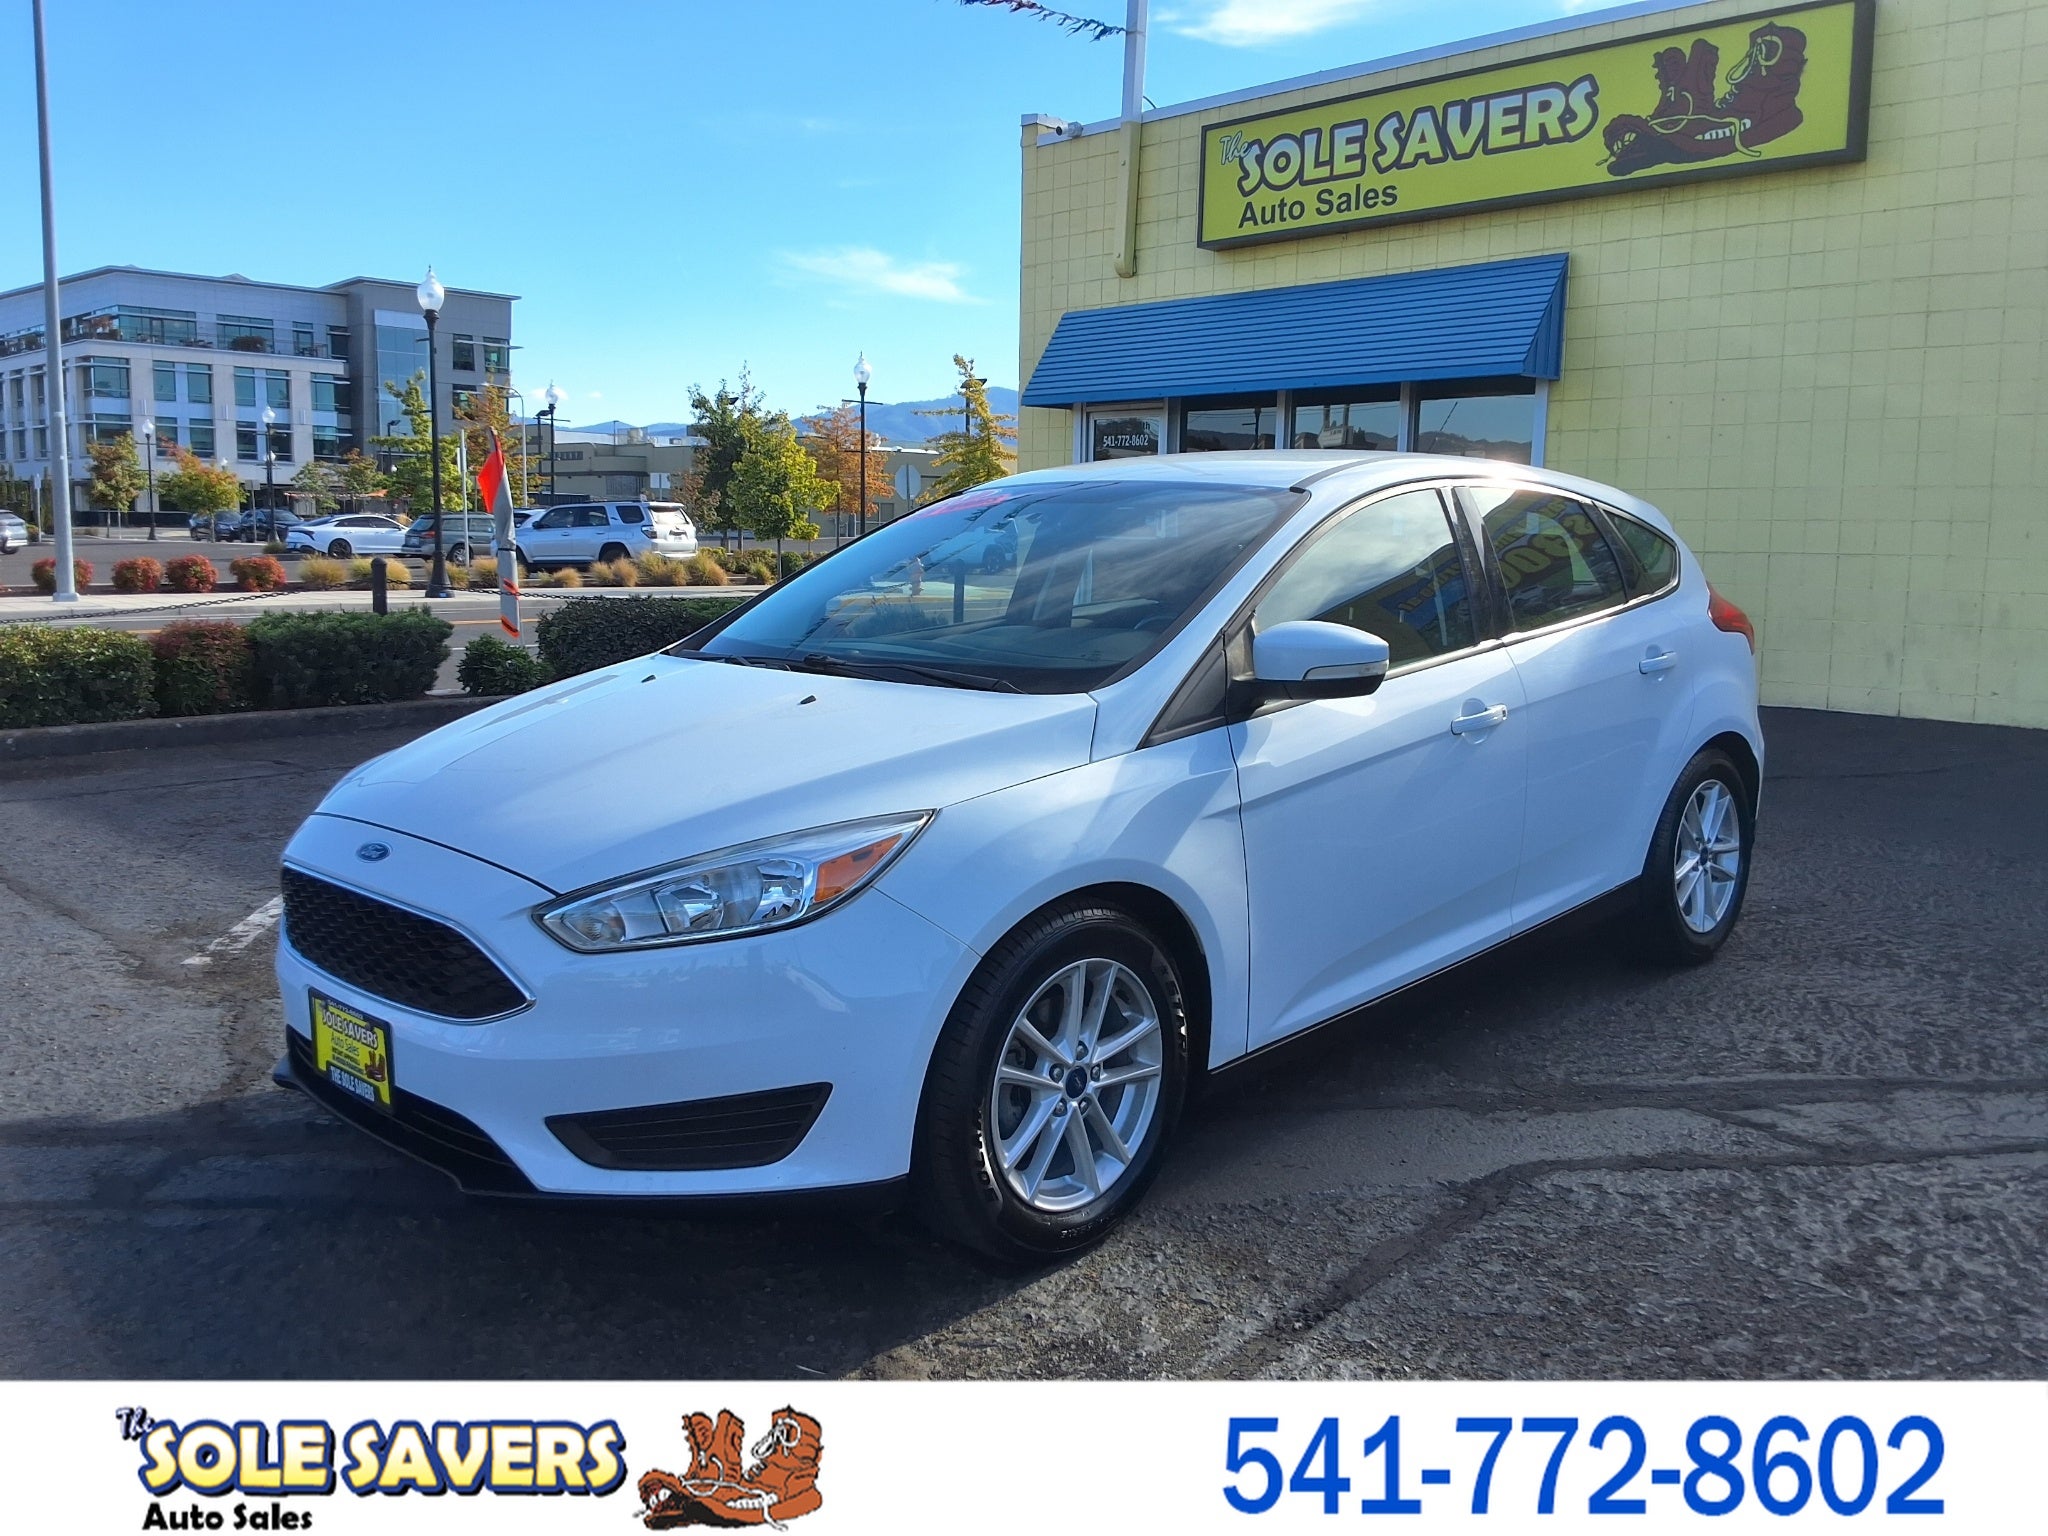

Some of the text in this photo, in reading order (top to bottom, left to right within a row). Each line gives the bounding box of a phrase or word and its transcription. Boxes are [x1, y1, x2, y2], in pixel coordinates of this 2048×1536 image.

[1220, 73, 1600, 197] The SOLE SAVERS
[1238, 184, 1398, 229] Auto Sales
[1103, 434, 1149, 448] 541-772-8602
[322, 1009, 344, 1033] SOLE
[343, 1020, 378, 1049] SAVERS
